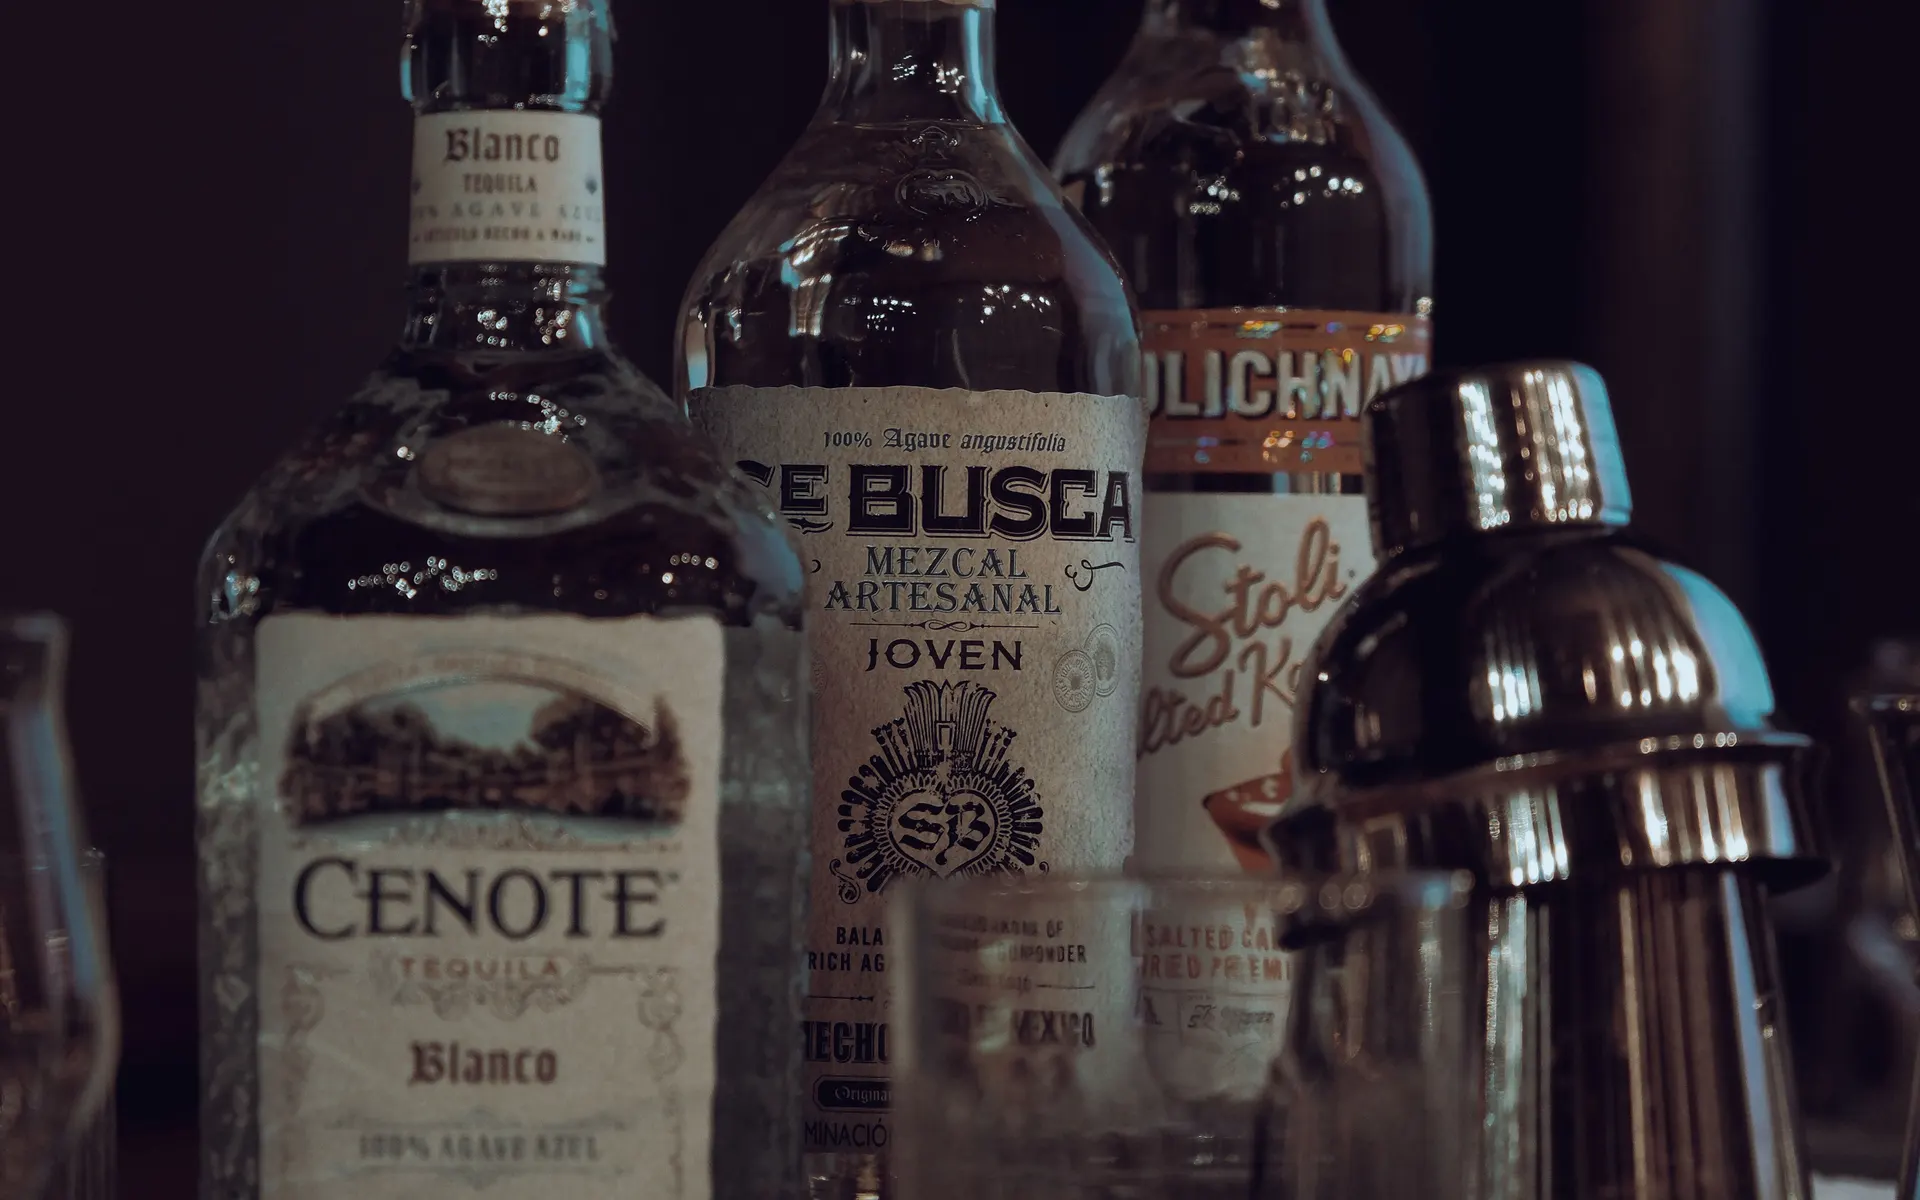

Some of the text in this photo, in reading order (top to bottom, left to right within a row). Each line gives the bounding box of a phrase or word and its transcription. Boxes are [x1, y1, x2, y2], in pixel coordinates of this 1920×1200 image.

[445, 127, 559, 163] Blanco
[463, 173, 539, 194] TEQUILA
[824, 427, 1066, 454] 100% Agave angustifolia
[846, 463, 1135, 544] BUSCA
[864, 545, 1030, 579] MEZCAL
[824, 580, 1063, 614] ARTESANAL
[1157, 514, 1347, 678] Stoli
[866, 637, 1022, 671] JOVEN
[1137, 668, 1240, 762] lted
[293, 854, 666, 942] CENOTE
[1146, 924, 1235, 951] SALTED
[399, 956, 563, 980] TEQUILA
[807, 952, 851, 971] RICH
[407, 1040, 559, 1086] Blanco
